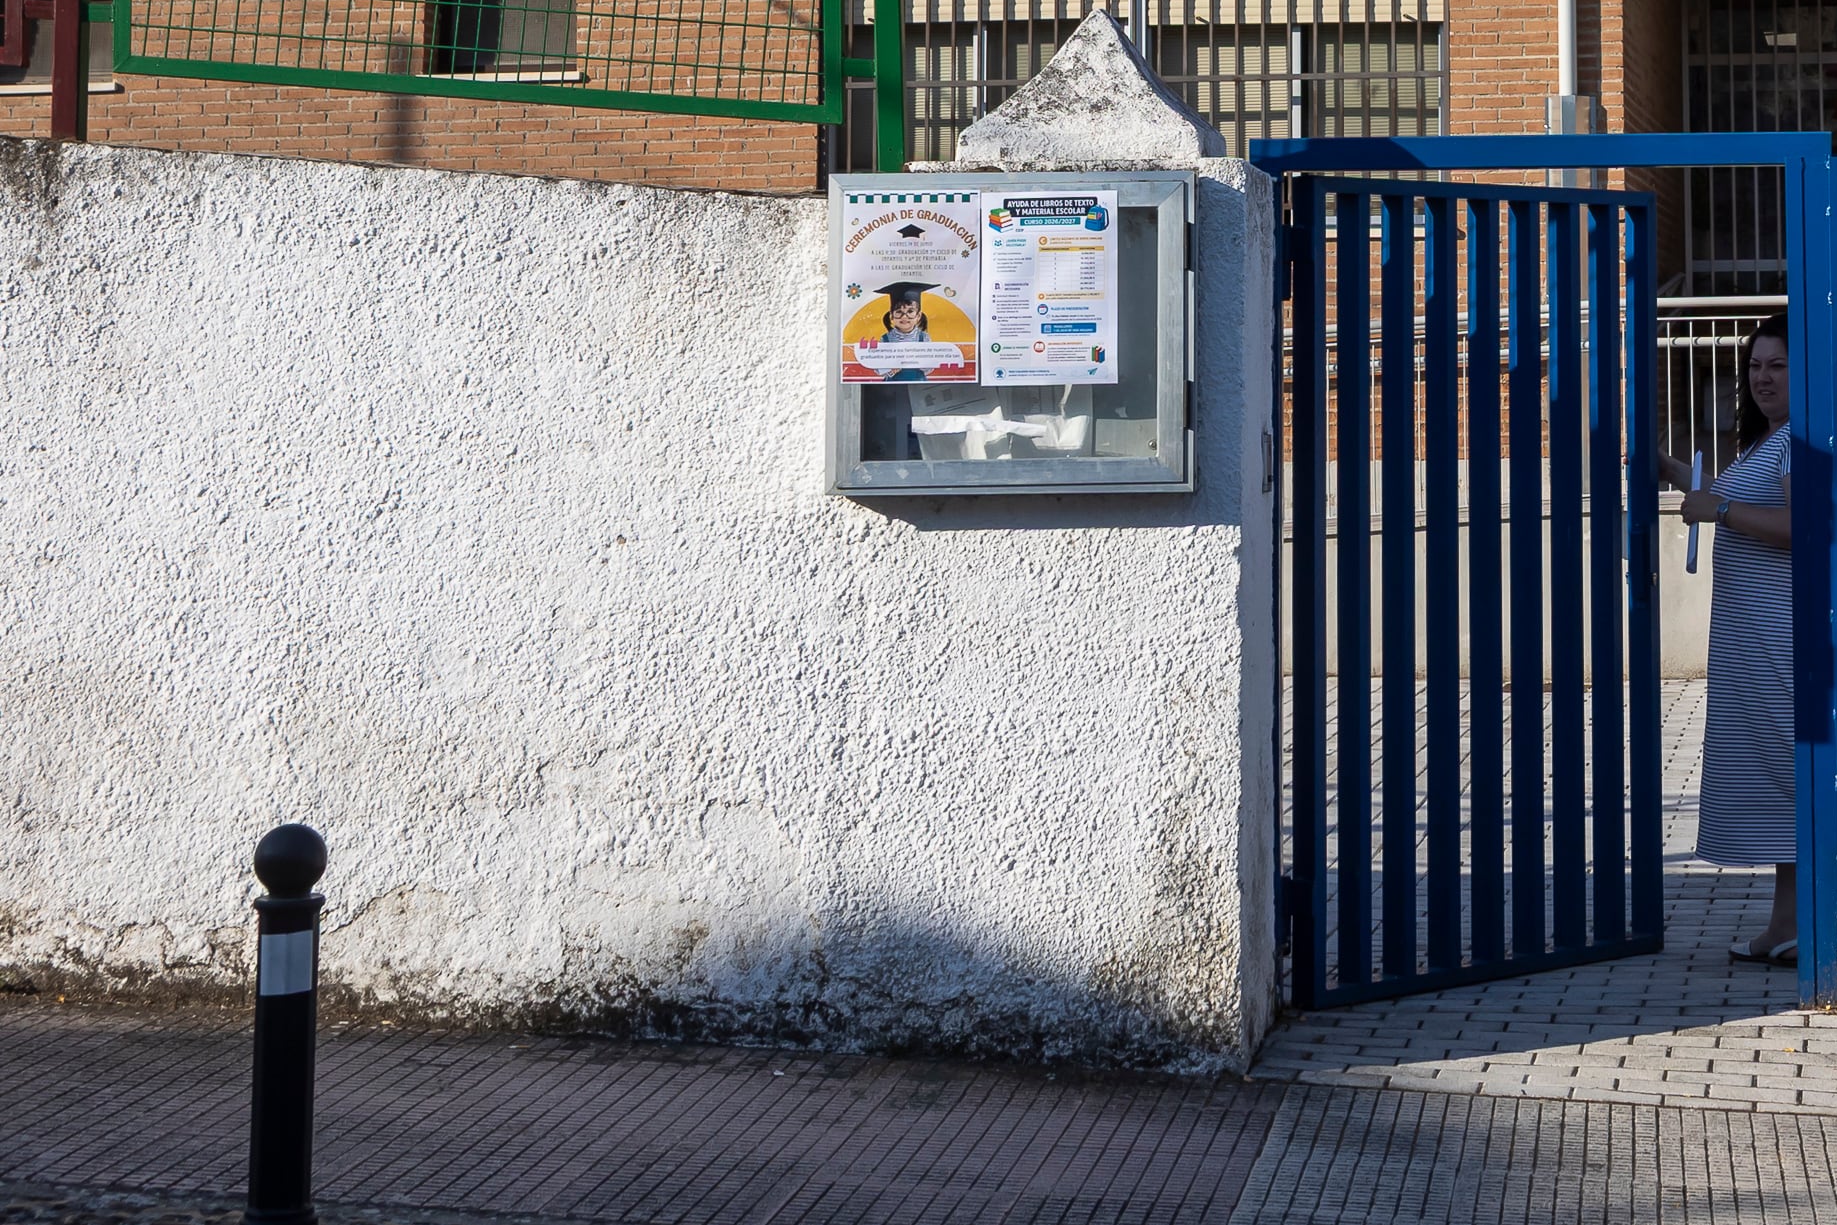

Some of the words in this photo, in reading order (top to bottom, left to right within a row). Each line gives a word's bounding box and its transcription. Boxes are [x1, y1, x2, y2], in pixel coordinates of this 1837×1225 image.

[1007, 200, 1029, 208] AYUDA
[1031, 200, 1039, 208] DE
[1040, 200, 1063, 208] LIBROS
[845, 212, 898, 253] CEREMONIA
[900, 209, 914, 219] DE
[917, 209, 978, 251] GRADUACIÓN
